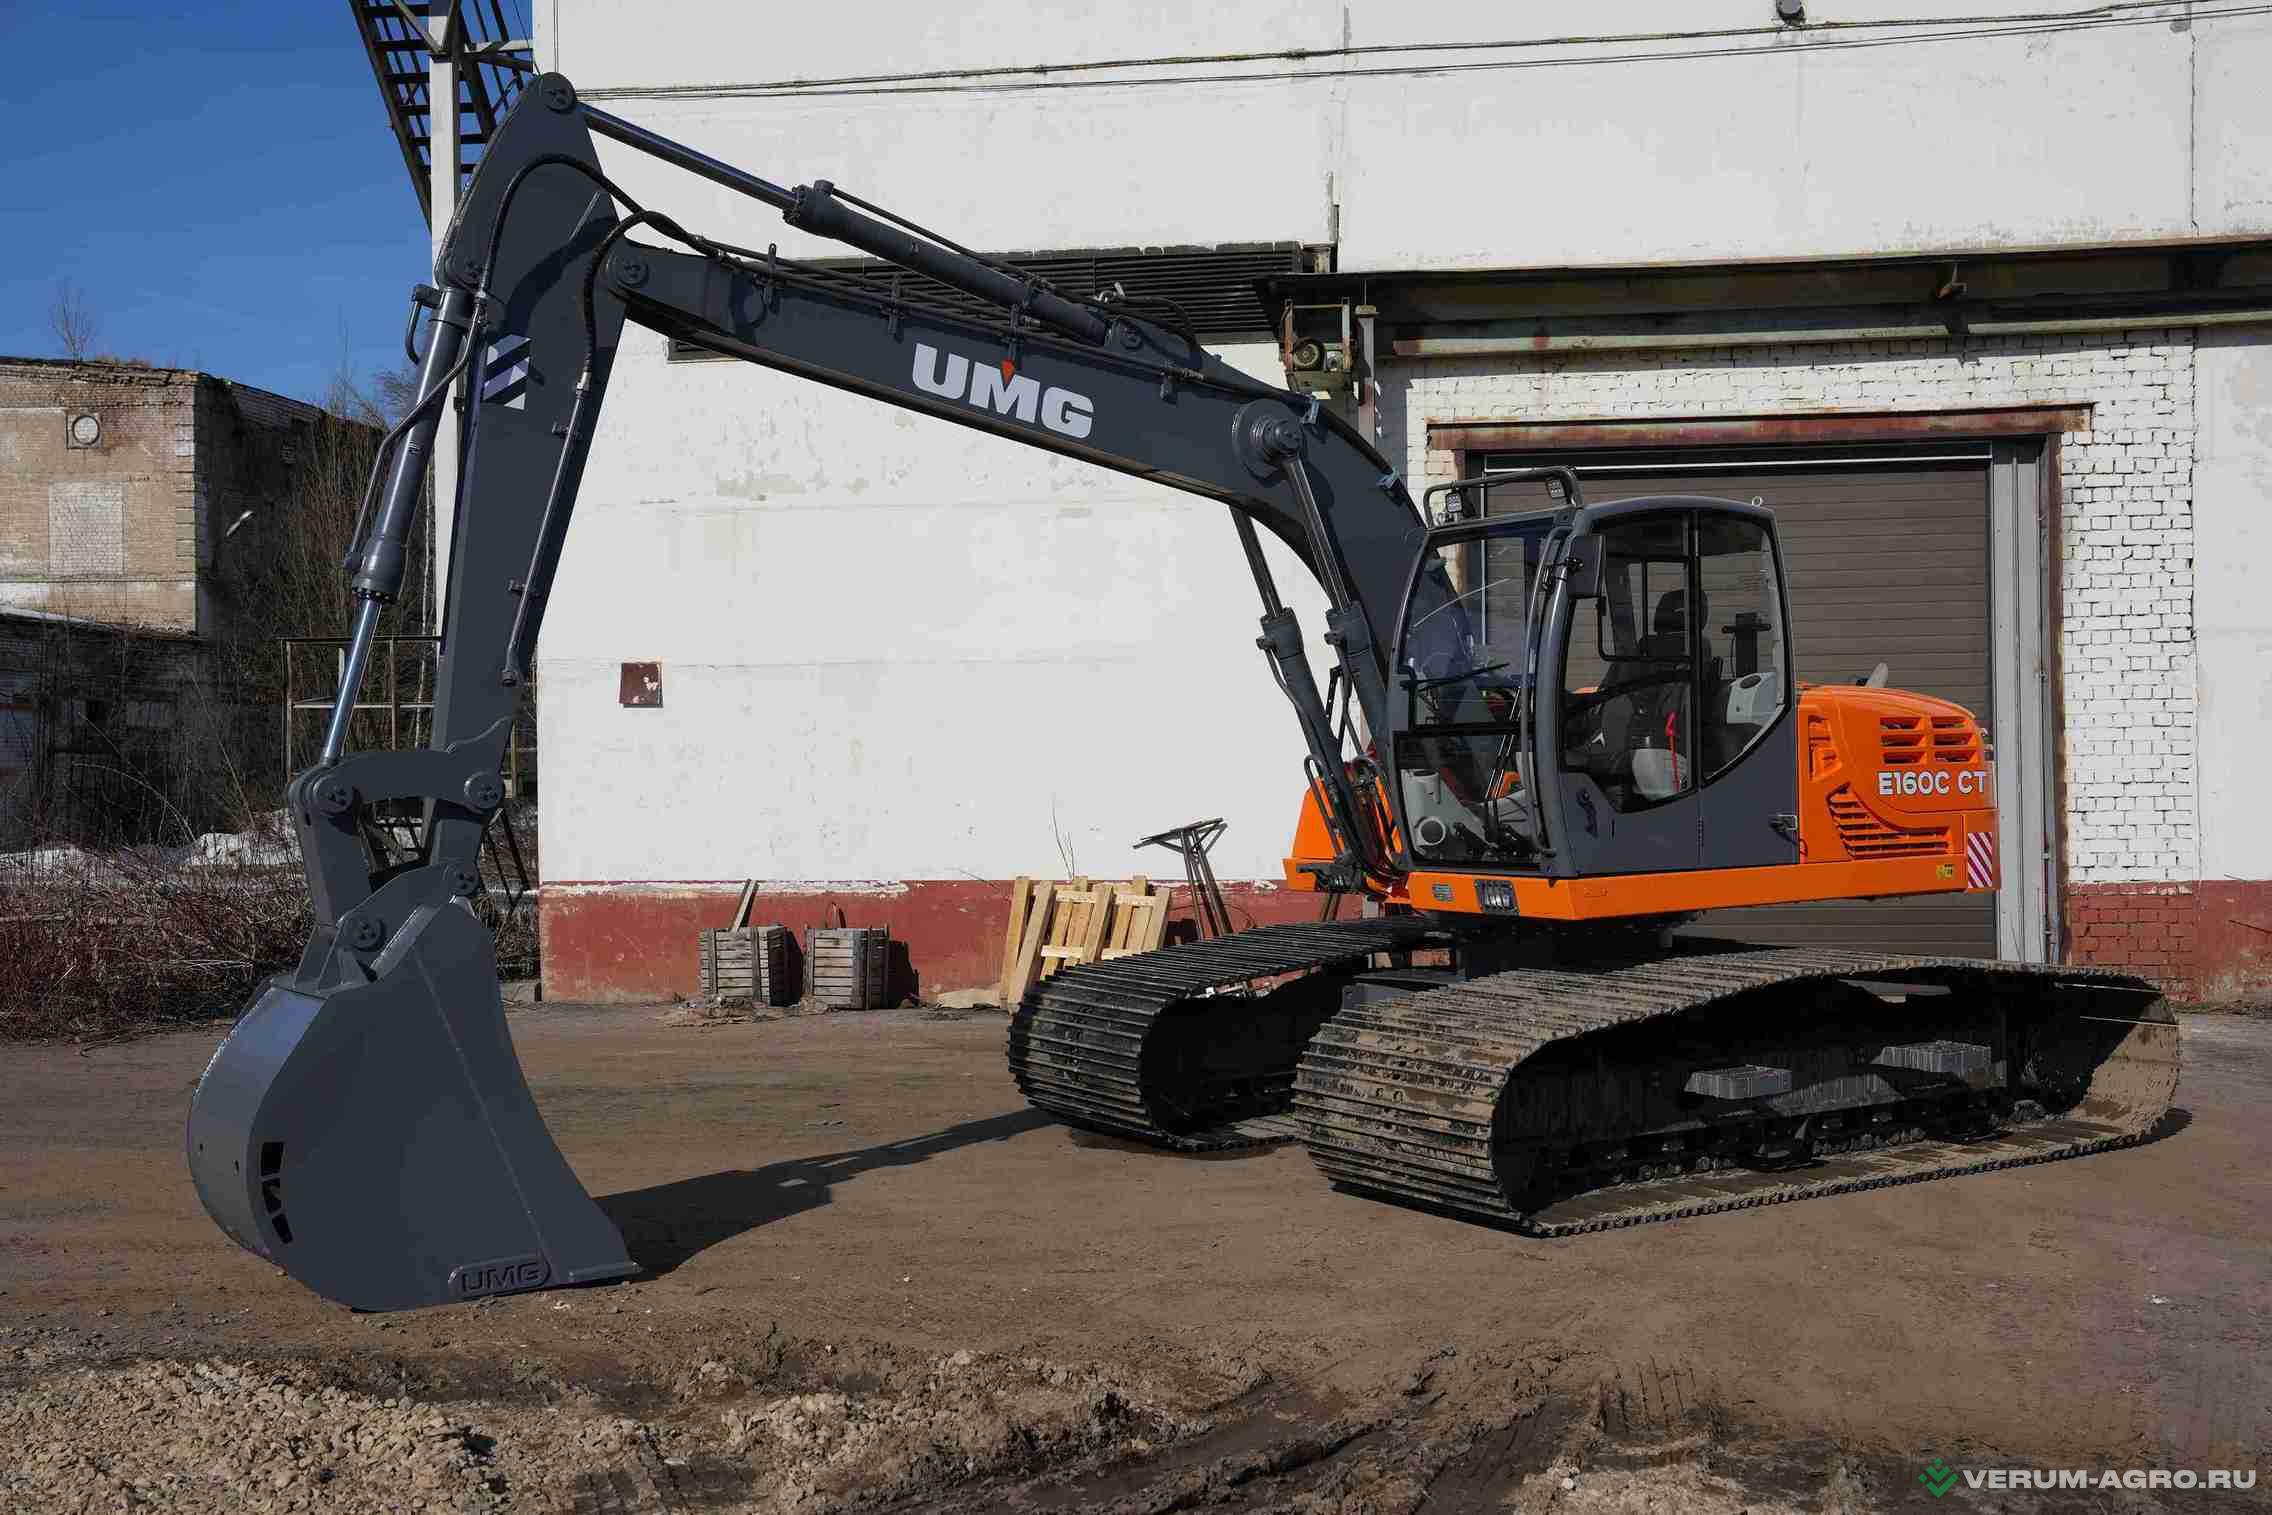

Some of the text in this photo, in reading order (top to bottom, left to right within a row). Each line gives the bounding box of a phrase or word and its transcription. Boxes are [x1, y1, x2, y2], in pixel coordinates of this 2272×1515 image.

[912, 343, 1095, 439] UMG
[1878, 770, 1986, 795] E160C CT
[461, 1261, 546, 1292] UMG
